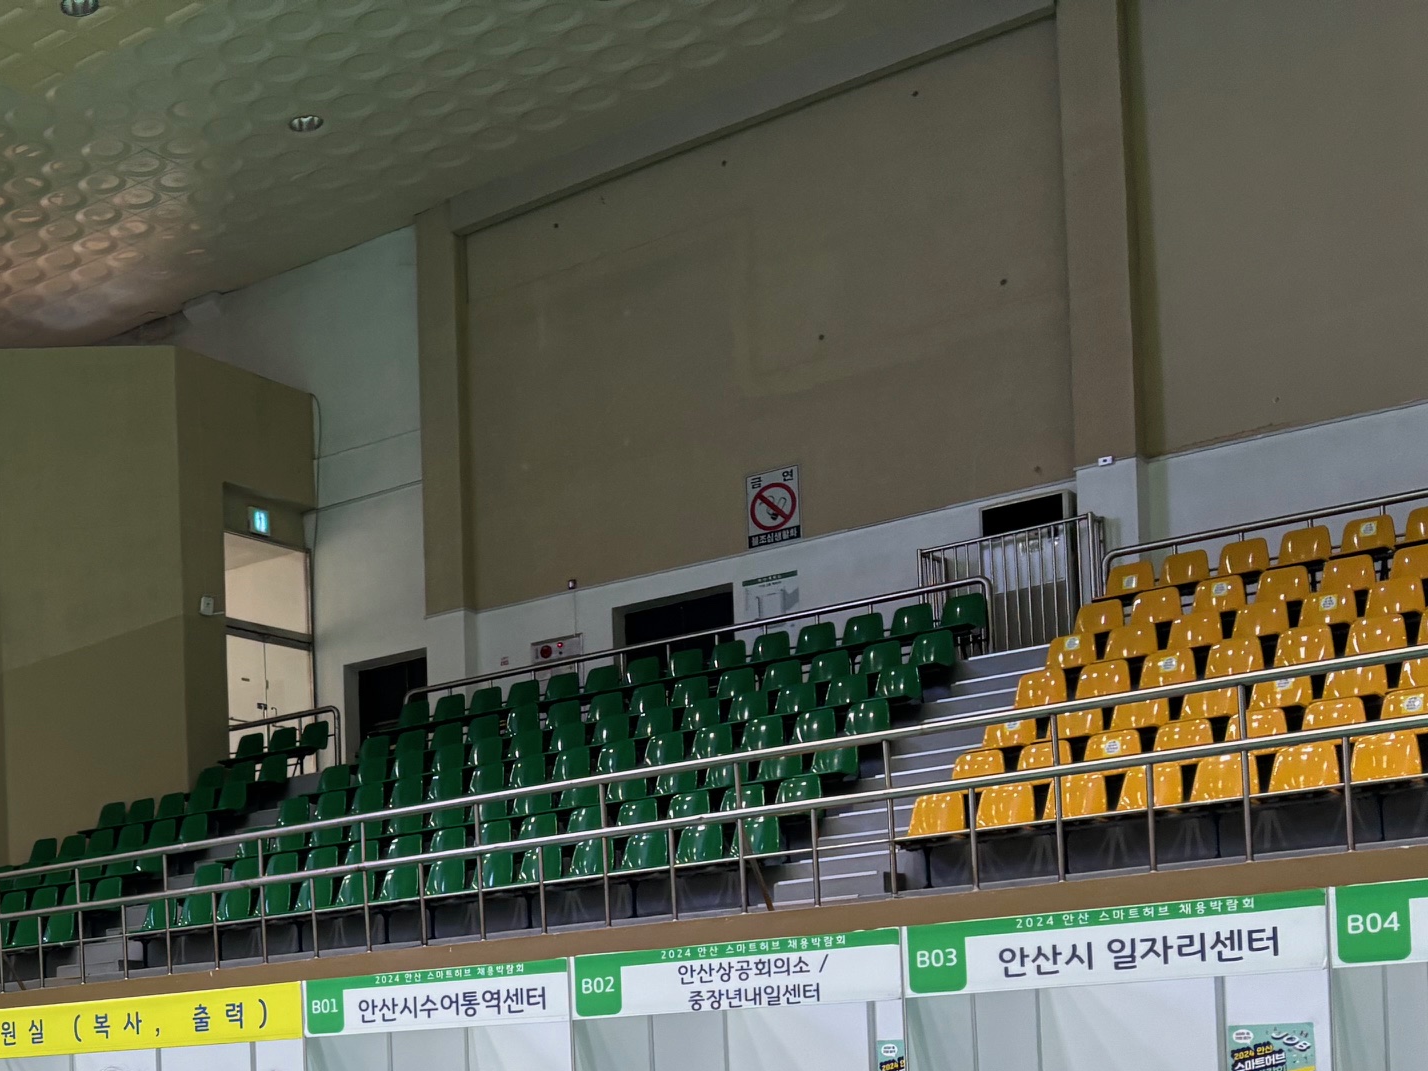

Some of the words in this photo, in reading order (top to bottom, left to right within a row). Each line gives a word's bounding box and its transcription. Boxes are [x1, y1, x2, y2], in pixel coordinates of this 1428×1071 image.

[1015, 915, 1054, 929] 2024
[1062, 912, 1090, 926] 안산
[1098, 904, 1170, 921] 스마트허브
[1178, 897, 1255, 915] 채용박람회
[1347, 911, 1400, 935] B04
[660, 948, 692, 960] 2024
[697, 946, 719, 958] 안산
[725, 940, 782, 956] 스마트허브
[787, 935, 846, 950] 채용박람회
[916, 948, 958, 968] B03
[998, 941, 1094, 978] 안산시
[1107, 926, 1279, 970] 일자리센터
[374, 974, 400, 984] 2024
[404, 972, 422, 983] 안산
[426, 968, 472, 980] 스마트허브
[476, 964, 524, 976] 채용박람회
[677, 955, 810, 986] 안산상공회의소
[581, 977, 615, 994] B02
[688, 982, 820, 1012] 중장년내일센터
[312, 998, 338, 1014] B01
[358, 986, 547, 1024] 안산시수어통역센터
[74, 1012, 160, 1042] (복사,
[192, 998, 268, 1033] 출력)
[1271, 1032, 1312, 1052] JOB
